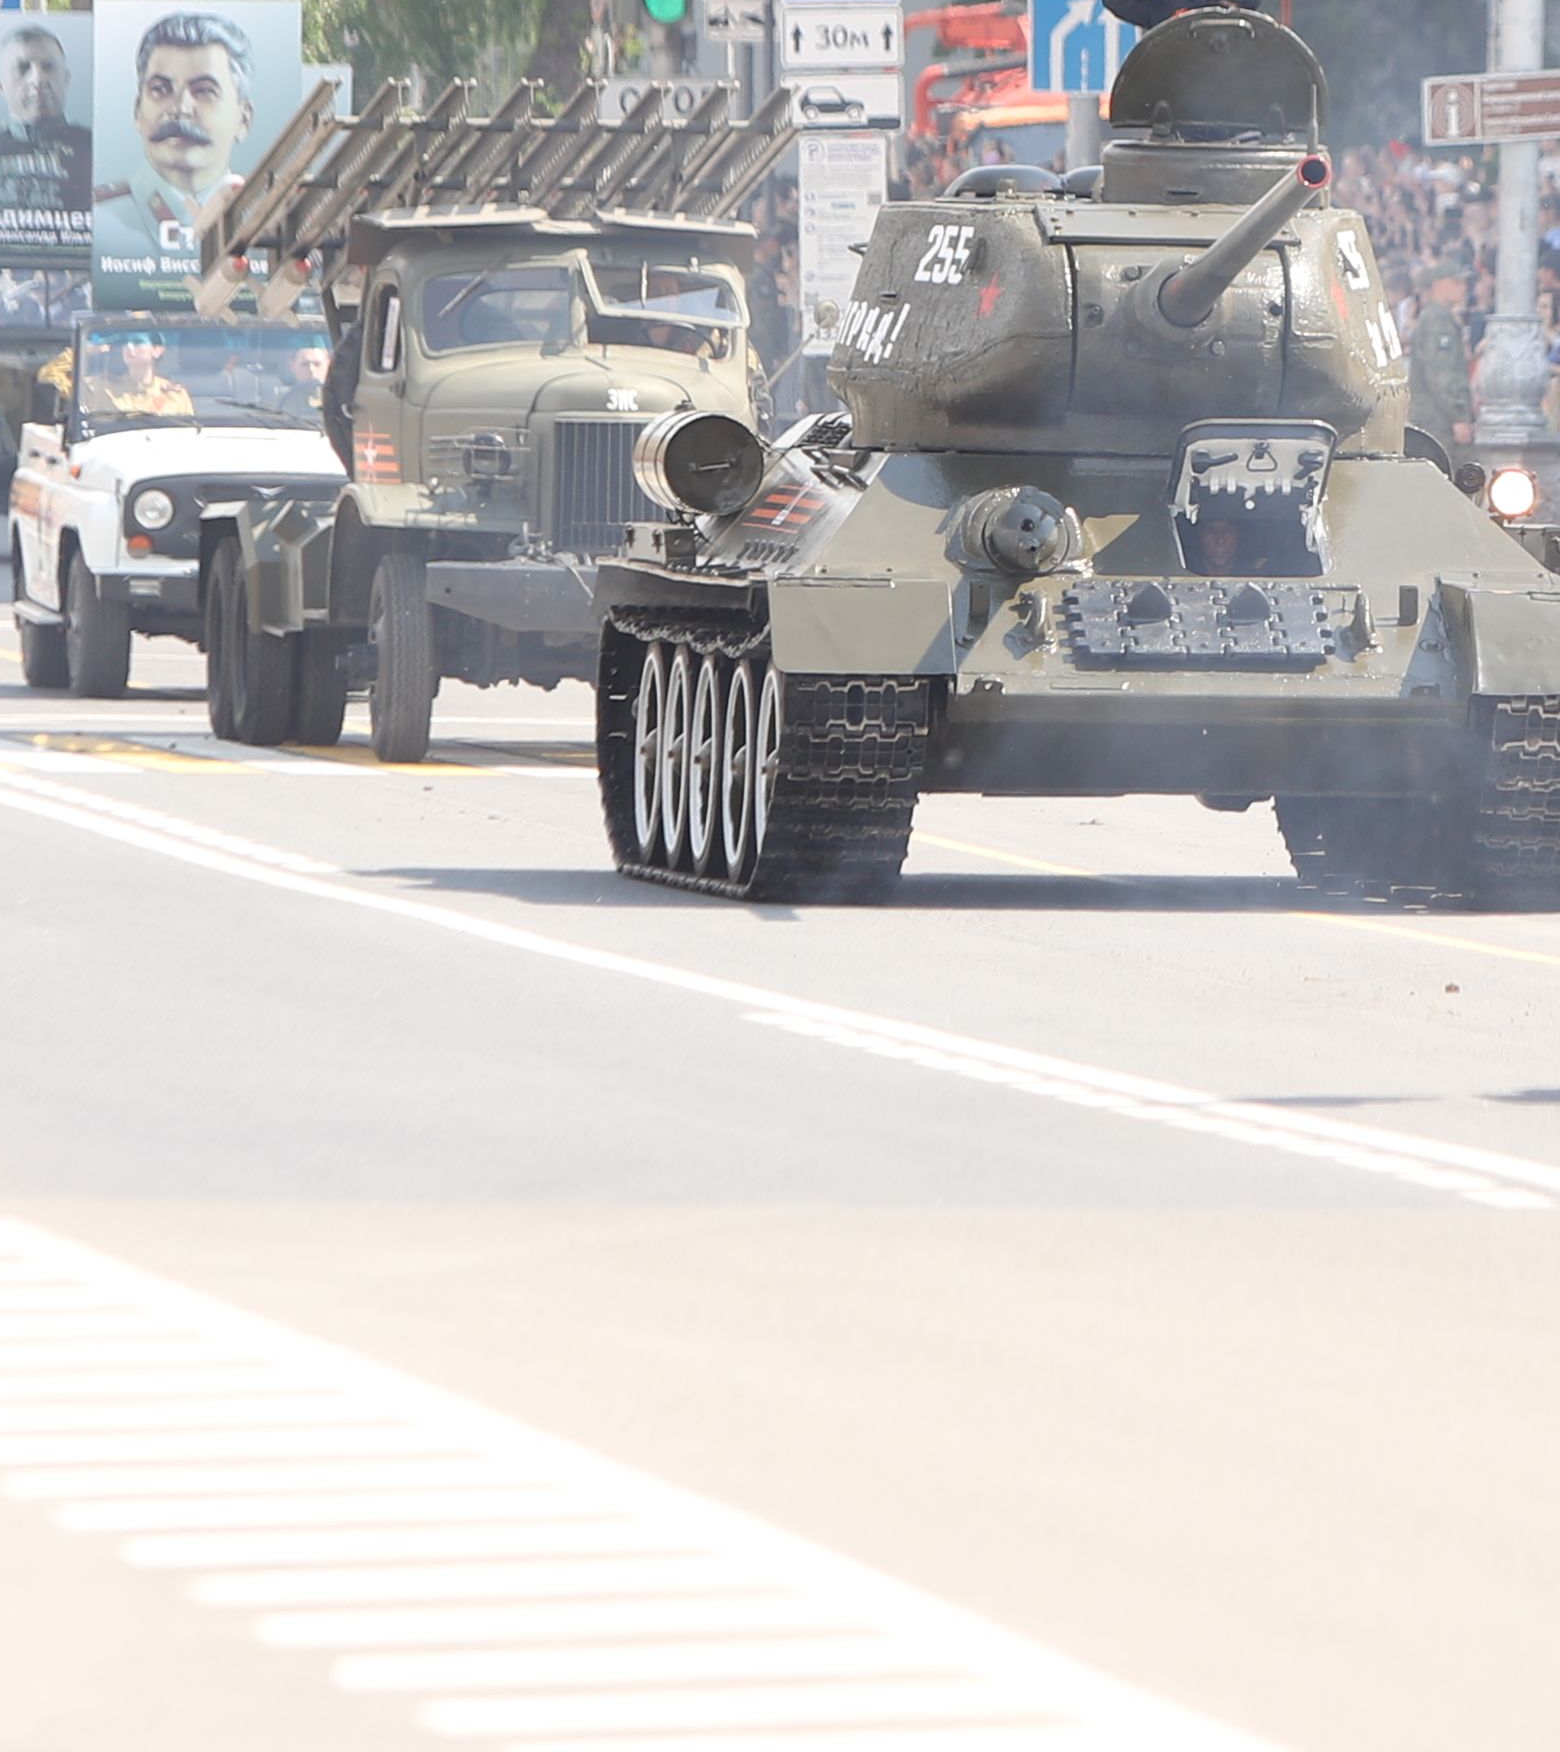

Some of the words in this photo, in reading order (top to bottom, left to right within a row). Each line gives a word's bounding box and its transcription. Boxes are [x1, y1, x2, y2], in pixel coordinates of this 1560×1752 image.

[100, 255, 158, 276] Иосиф
[913, 224, 975, 285] 255
[605, 387, 640, 412] ЗИС
